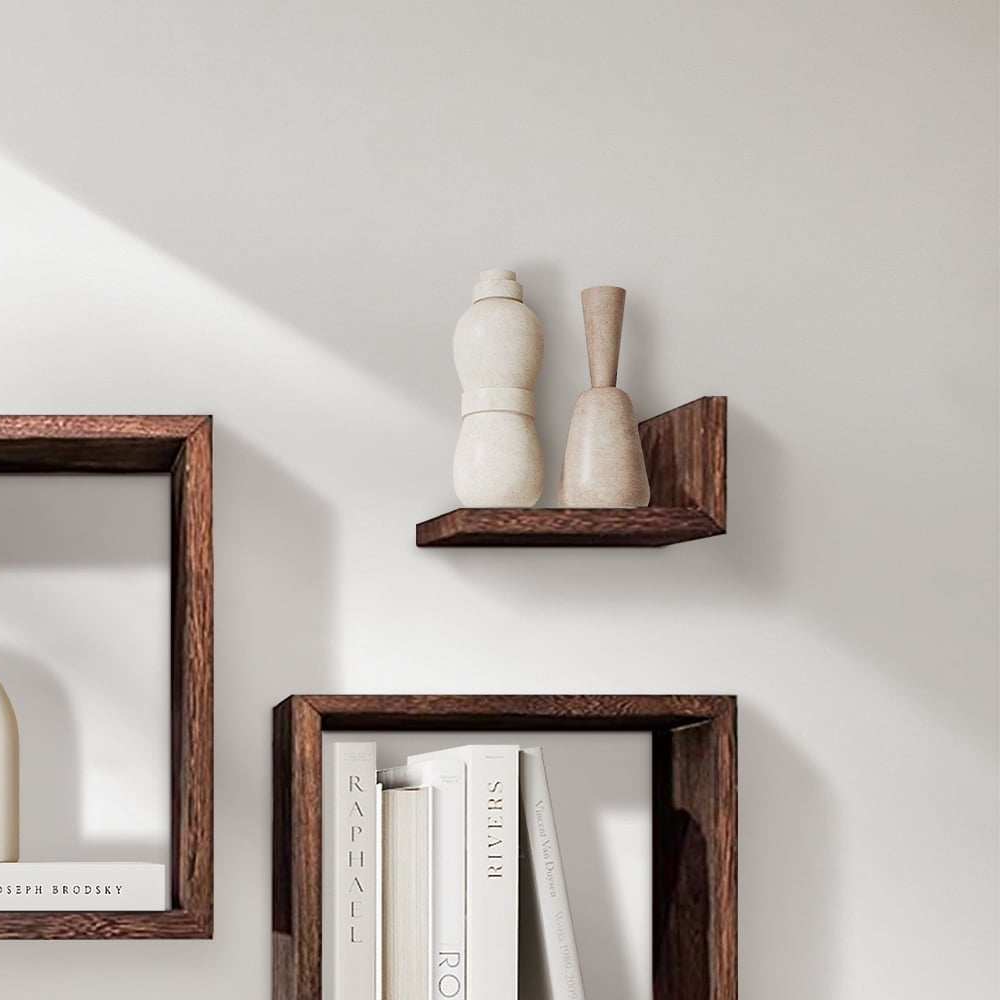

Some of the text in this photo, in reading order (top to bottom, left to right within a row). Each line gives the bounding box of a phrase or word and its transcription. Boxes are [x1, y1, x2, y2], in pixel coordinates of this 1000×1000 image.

[347, 774, 367, 944] RAPHAEL
[487, 779, 503, 880] RIVERS
[52, 884, 124, 896] BRODSKY
